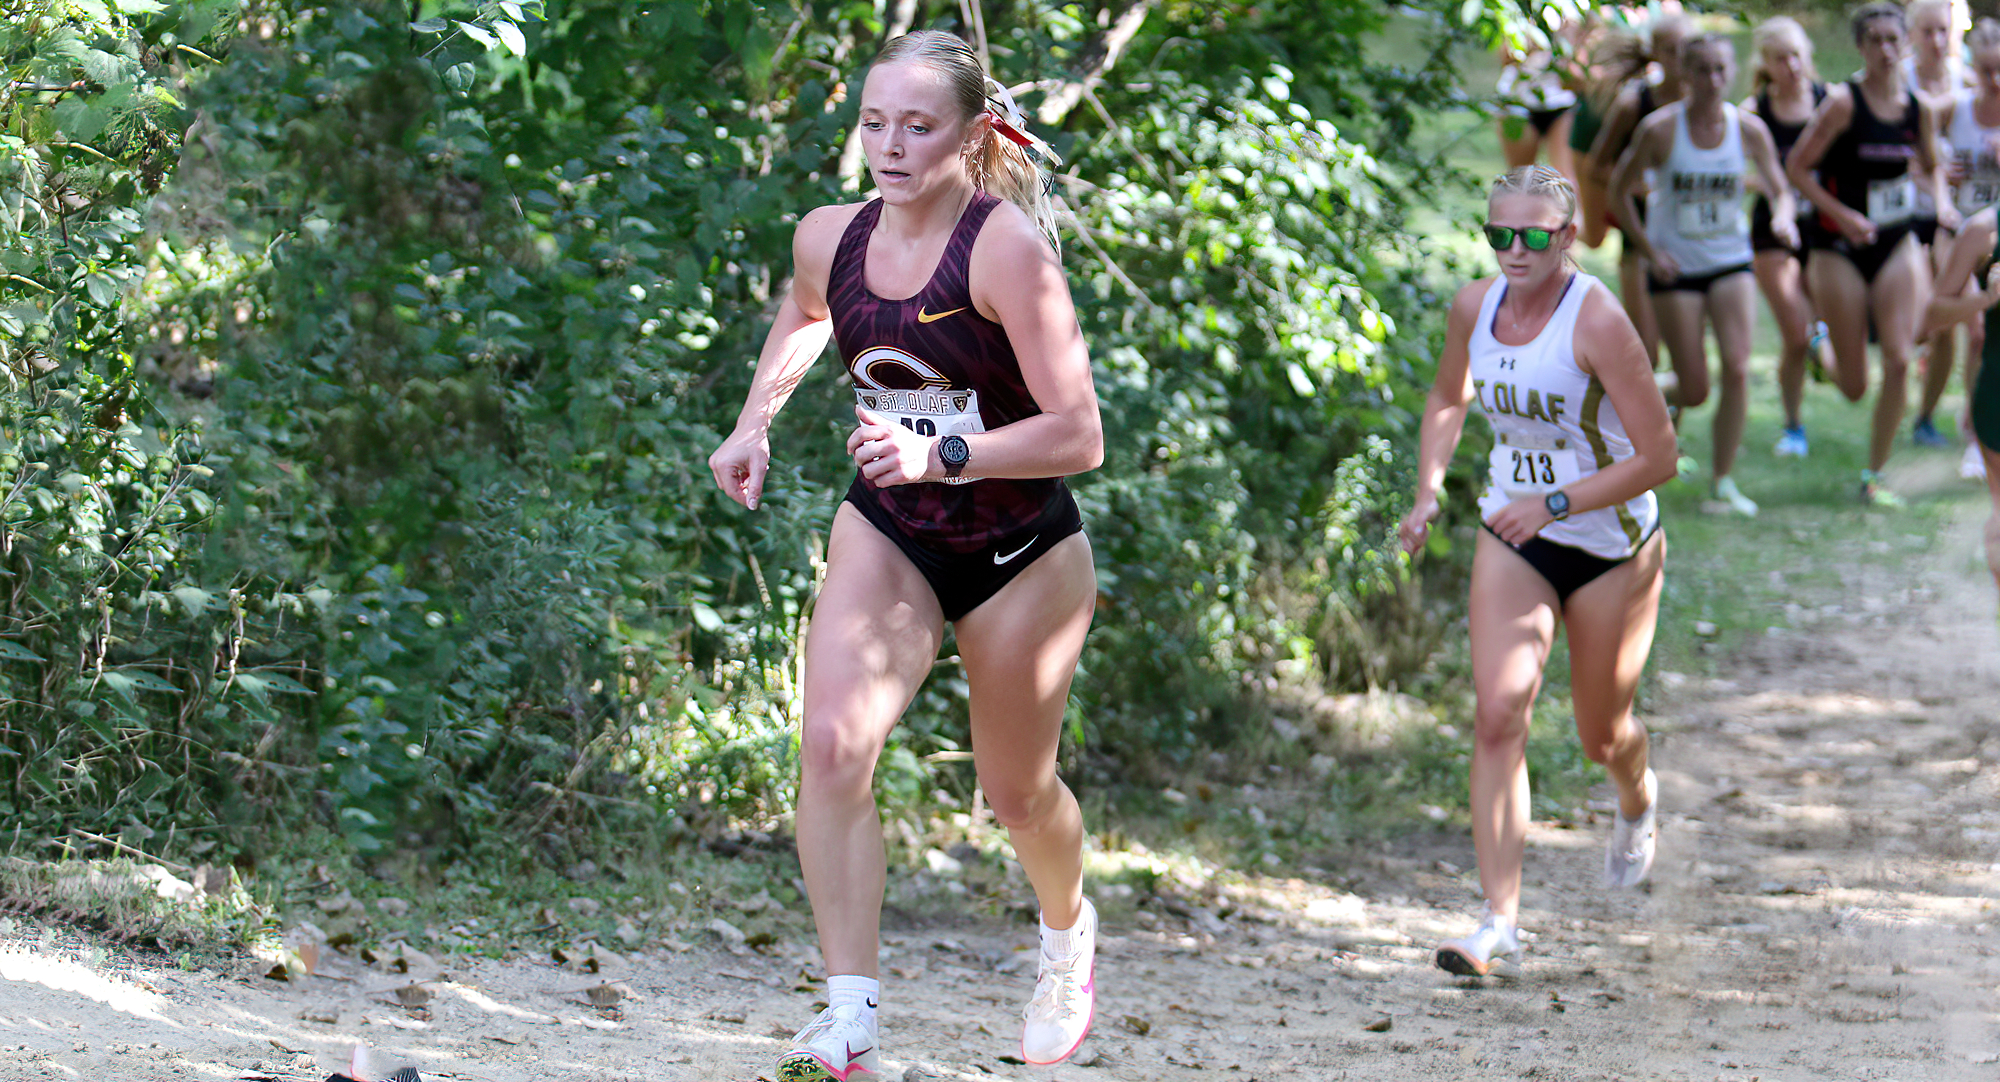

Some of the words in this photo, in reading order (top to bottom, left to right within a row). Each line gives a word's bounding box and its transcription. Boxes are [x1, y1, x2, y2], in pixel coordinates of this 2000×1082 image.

[879, 391, 904, 412] ST.
[906, 393, 950, 414] OLAF
[1494, 382, 1565, 424] OLAF
[1512, 450, 1555, 484] 213
